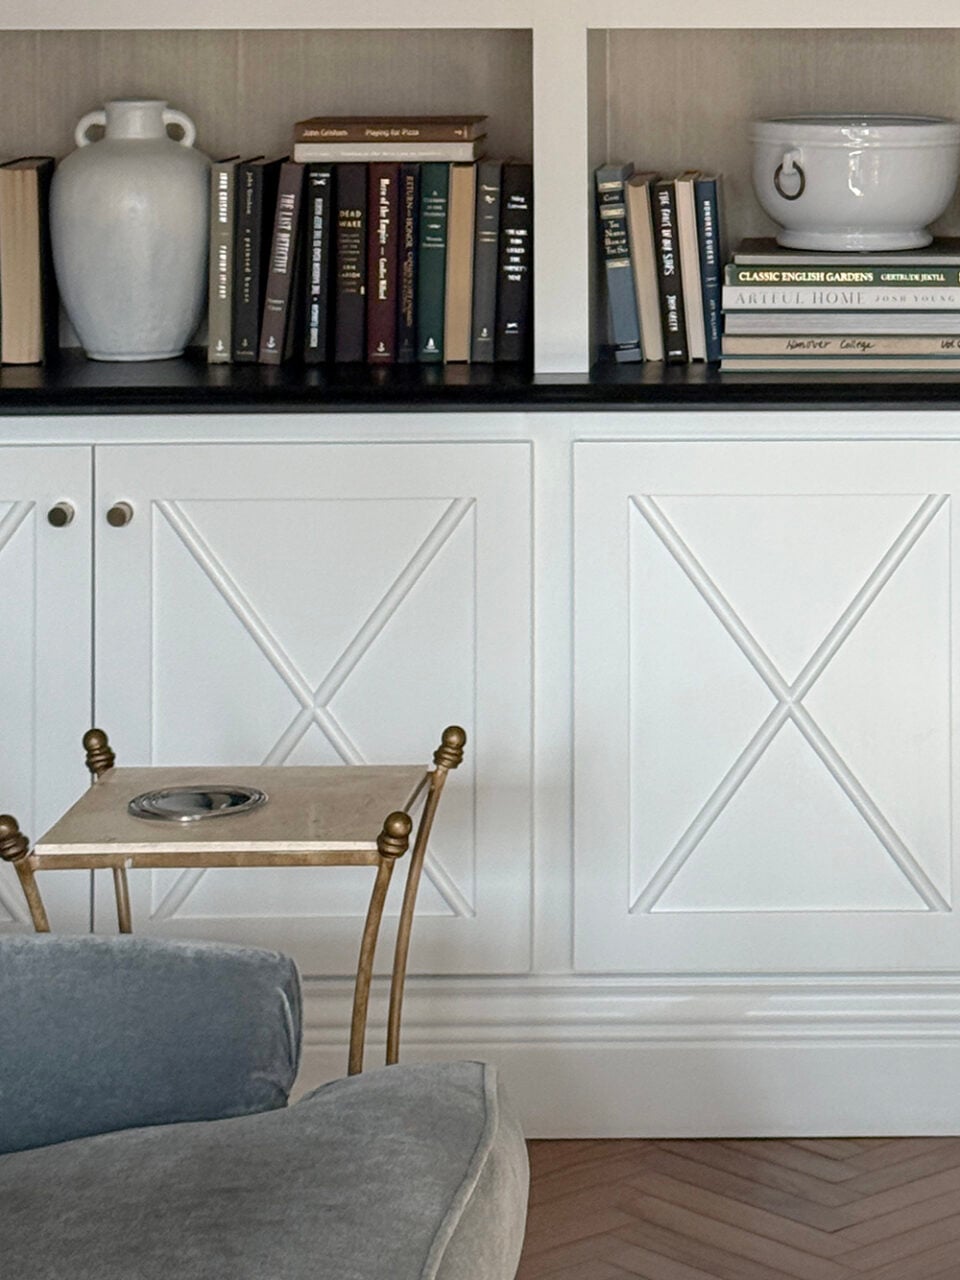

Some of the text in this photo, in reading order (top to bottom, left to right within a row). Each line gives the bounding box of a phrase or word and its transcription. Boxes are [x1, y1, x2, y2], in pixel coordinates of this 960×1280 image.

[302, 129, 320, 137] John
[365, 129, 390, 138] Playing
[379, 178, 390, 196] Hero
[379, 197, 390, 205] of
[659, 191, 670, 205] THE
[379, 206, 390, 218] the
[660, 208, 671, 227] FAULT
[661, 229, 672, 238] IN
[703, 200, 714, 265] HONORED GUEST
[663, 253, 675, 276] STARS
[738, 271, 874, 282] CLASSIC ENGLISH GARDENS
[735, 291, 865, 305] ARTFUL HOME
[875, 294, 955, 303] JOSH YOUNG
[786, 339, 876, 351] Hanover College
